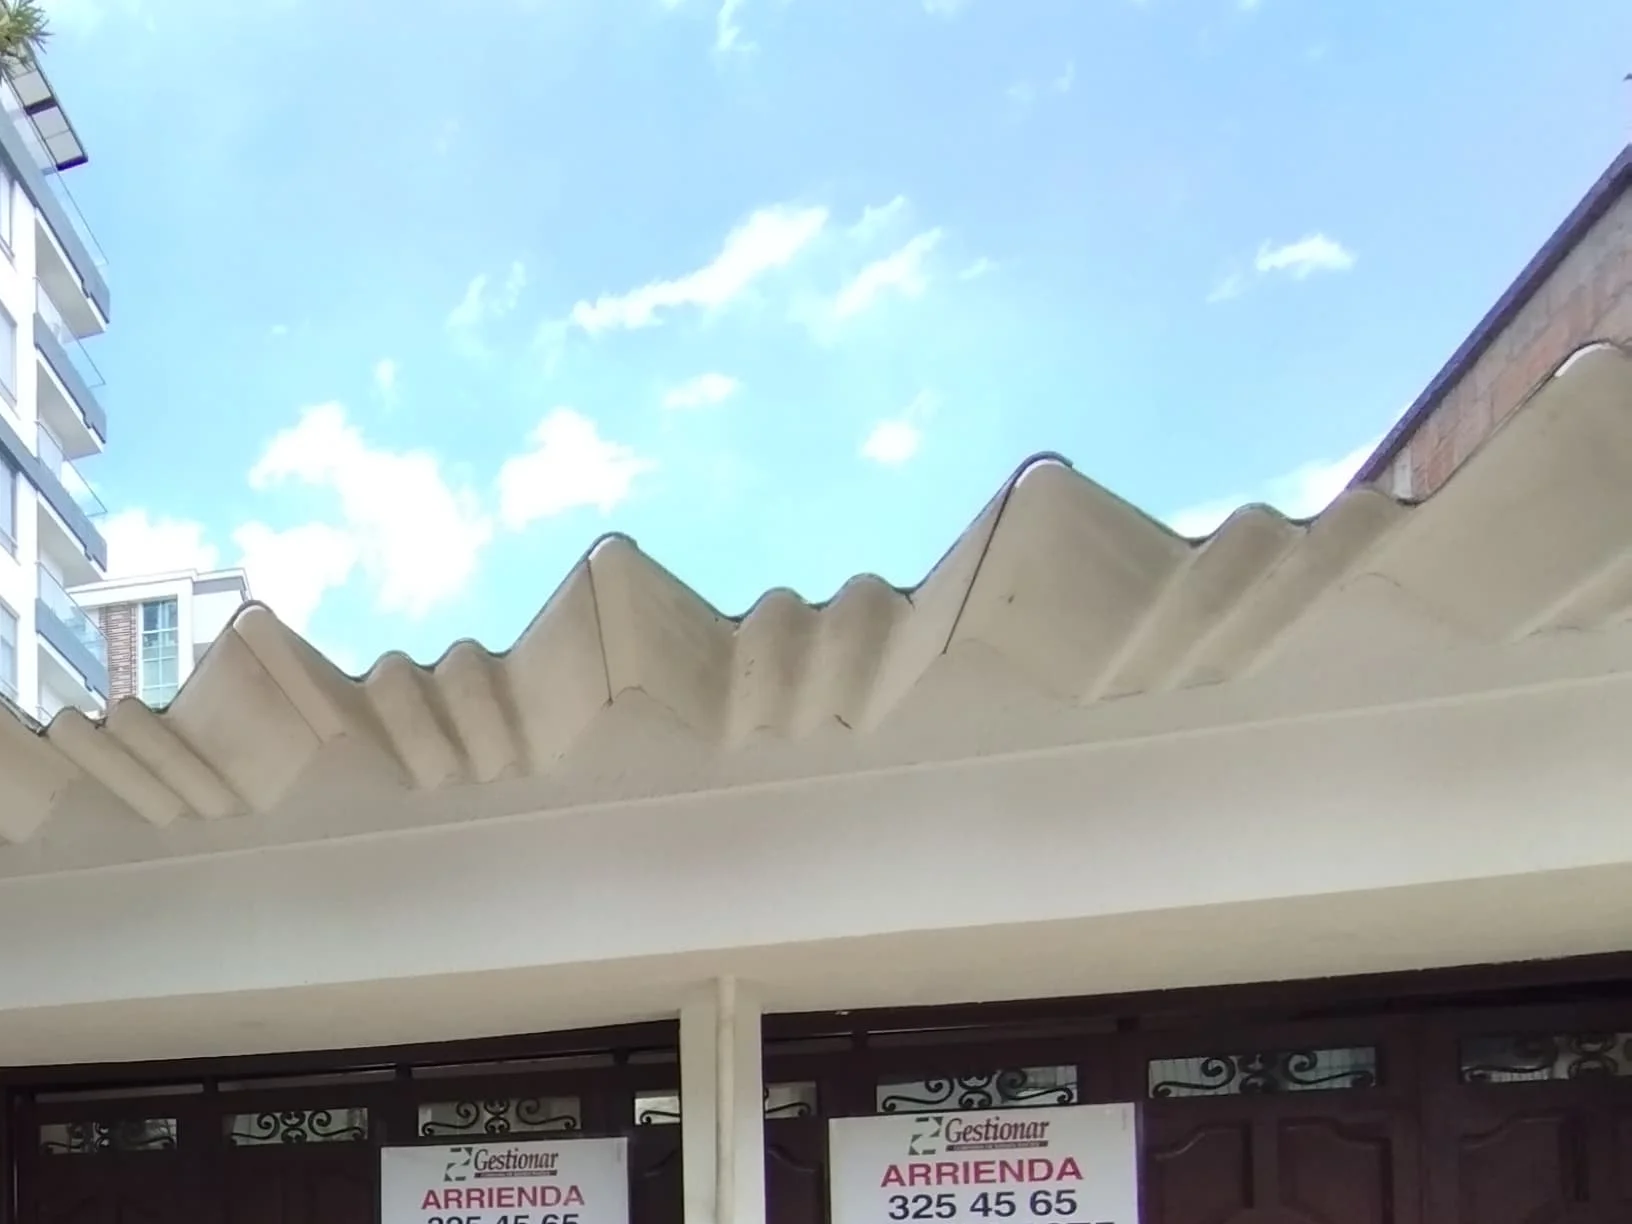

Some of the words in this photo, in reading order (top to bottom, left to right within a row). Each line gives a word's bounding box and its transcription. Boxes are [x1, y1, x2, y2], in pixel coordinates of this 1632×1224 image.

[945, 1116, 1050, 1144] Gestionar
[474, 1147, 559, 1171] Gestionar
[881, 1156, 1084, 1188] ARRIENDA
[421, 1185, 585, 1210] ARRIENDA
[888, 1193, 957, 1220] 325
[970, 1191, 1016, 1217] 45
[1029, 1189, 1078, 1216] 65
